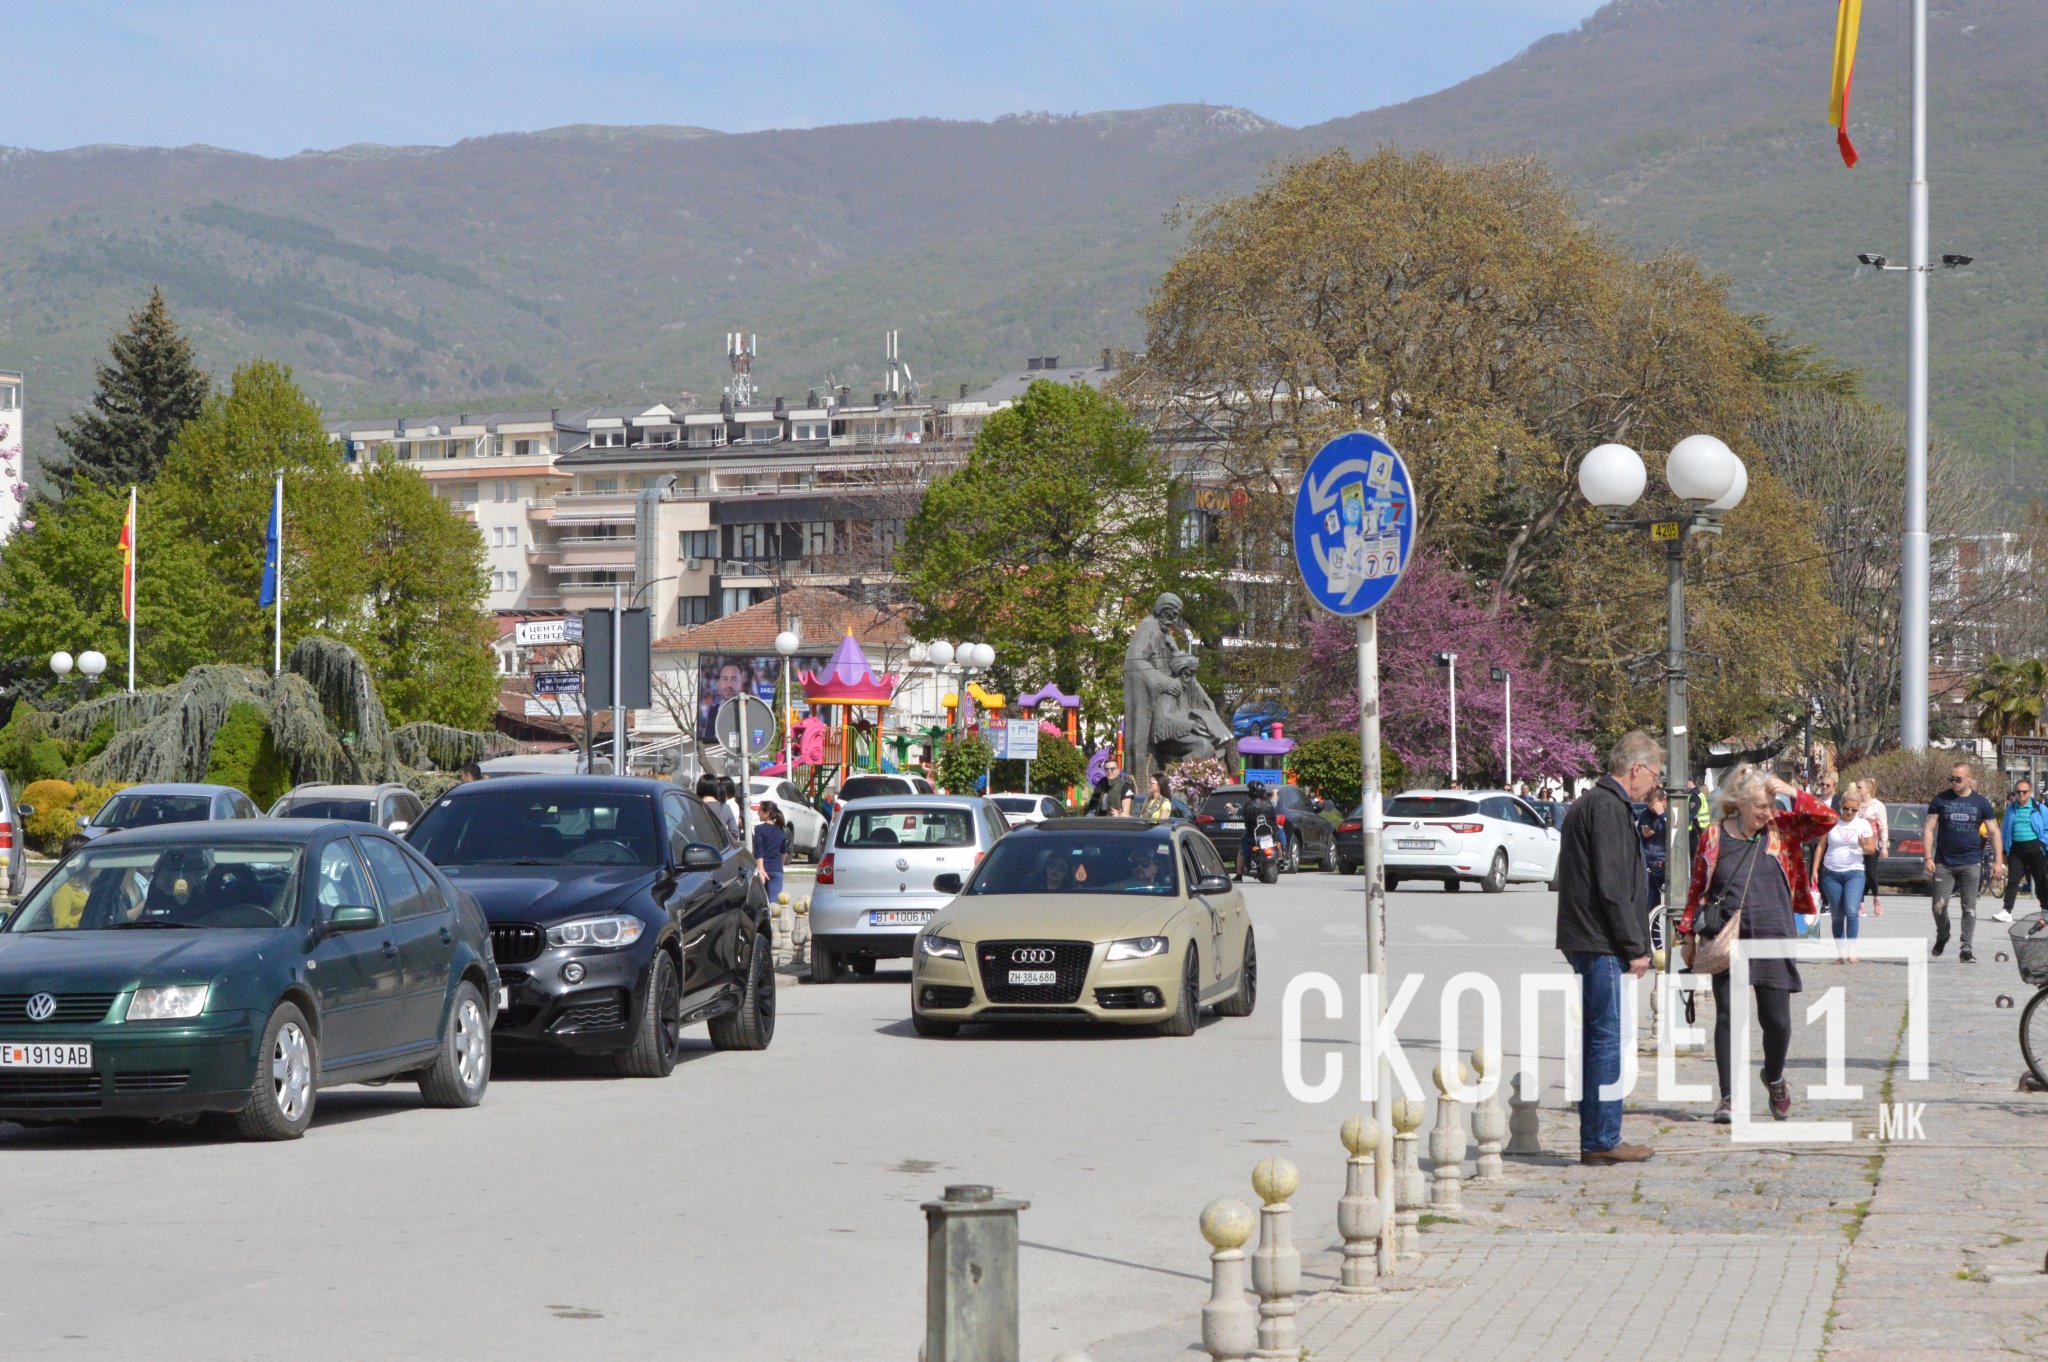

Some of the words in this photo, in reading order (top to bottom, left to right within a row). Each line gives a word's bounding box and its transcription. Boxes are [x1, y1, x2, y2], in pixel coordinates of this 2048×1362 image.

[1376, 462, 1386, 476] 4
[1391, 502, 1406, 522] 7
[1655, 524, 1677, 537] 4205
[1368, 560, 1376, 575] 7
[1386, 556, 1394, 571] 7
[876, 912, 888, 922] BT
[896, 911, 919, 922] 1006
[1039, 973, 1055, 983] 680
[0, 1046, 12, 1064] E
[24, 1046, 64, 1064] 1919
[68, 1047, 88, 1065] AB
